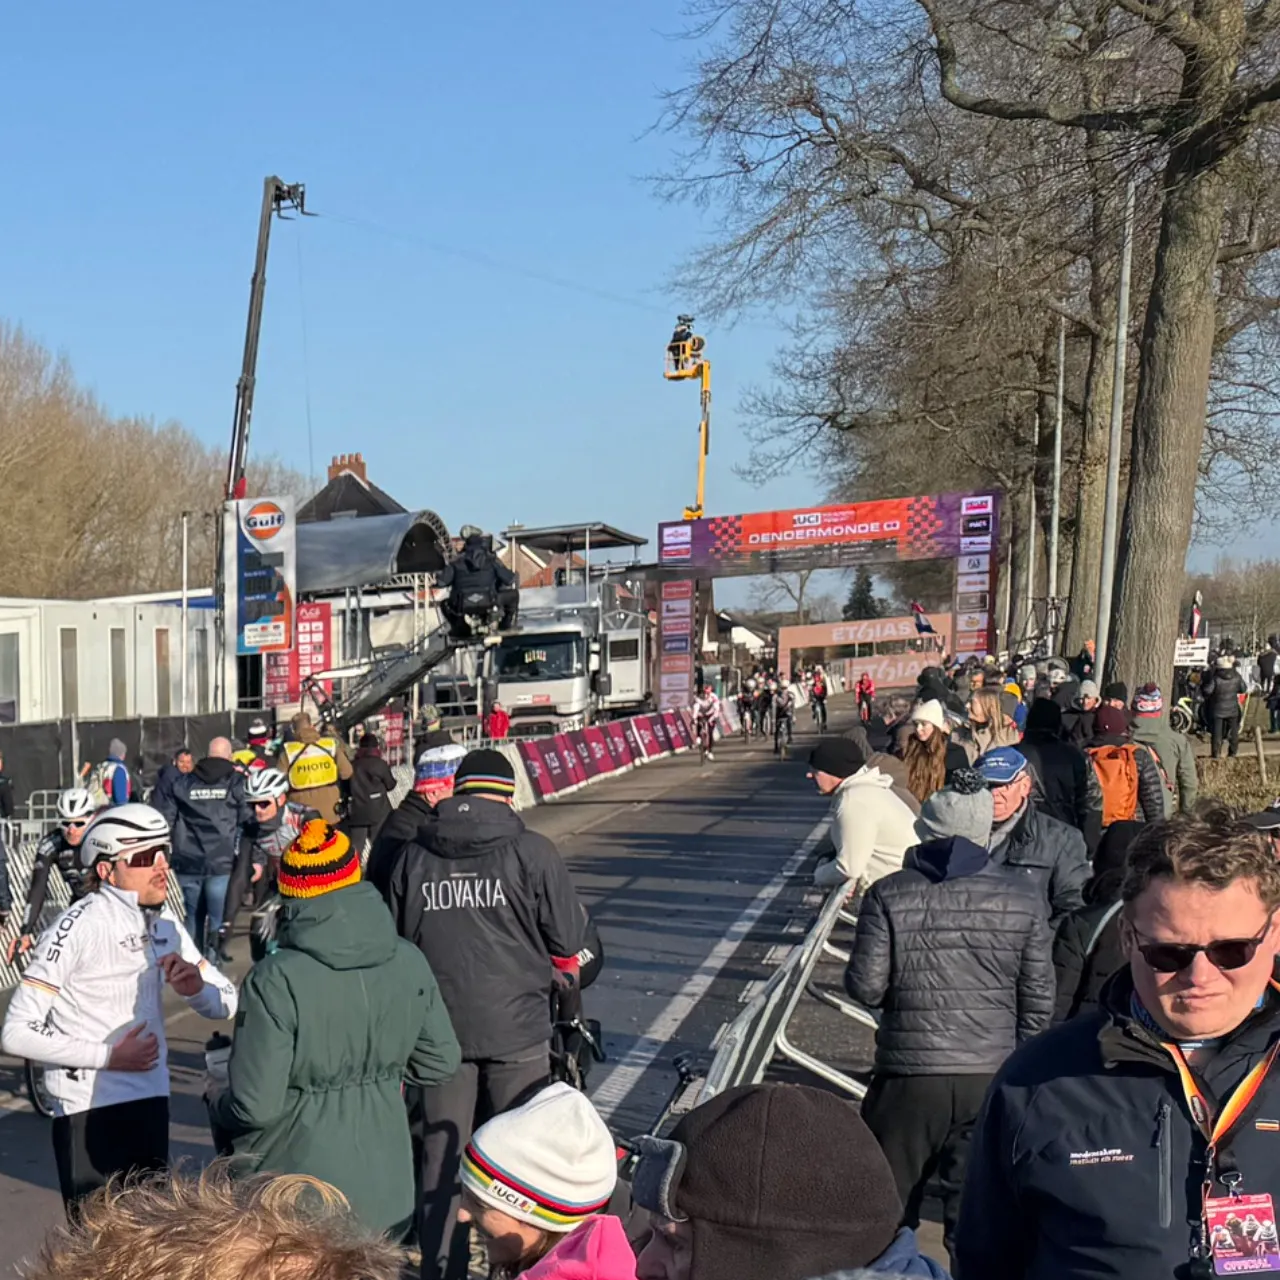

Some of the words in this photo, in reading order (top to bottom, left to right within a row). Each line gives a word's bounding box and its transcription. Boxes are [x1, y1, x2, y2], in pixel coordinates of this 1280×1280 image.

[245, 513, 284, 529] Gulf
[797, 514, 819, 525] UCI
[748, 522, 880, 544] DENDERMONDE
[831, 621, 912, 642] ETHIAS
[296, 761, 331, 774] PHOTO
[422, 878, 507, 911] SLOVAKIA
[495, 1186, 520, 1205] UCI
